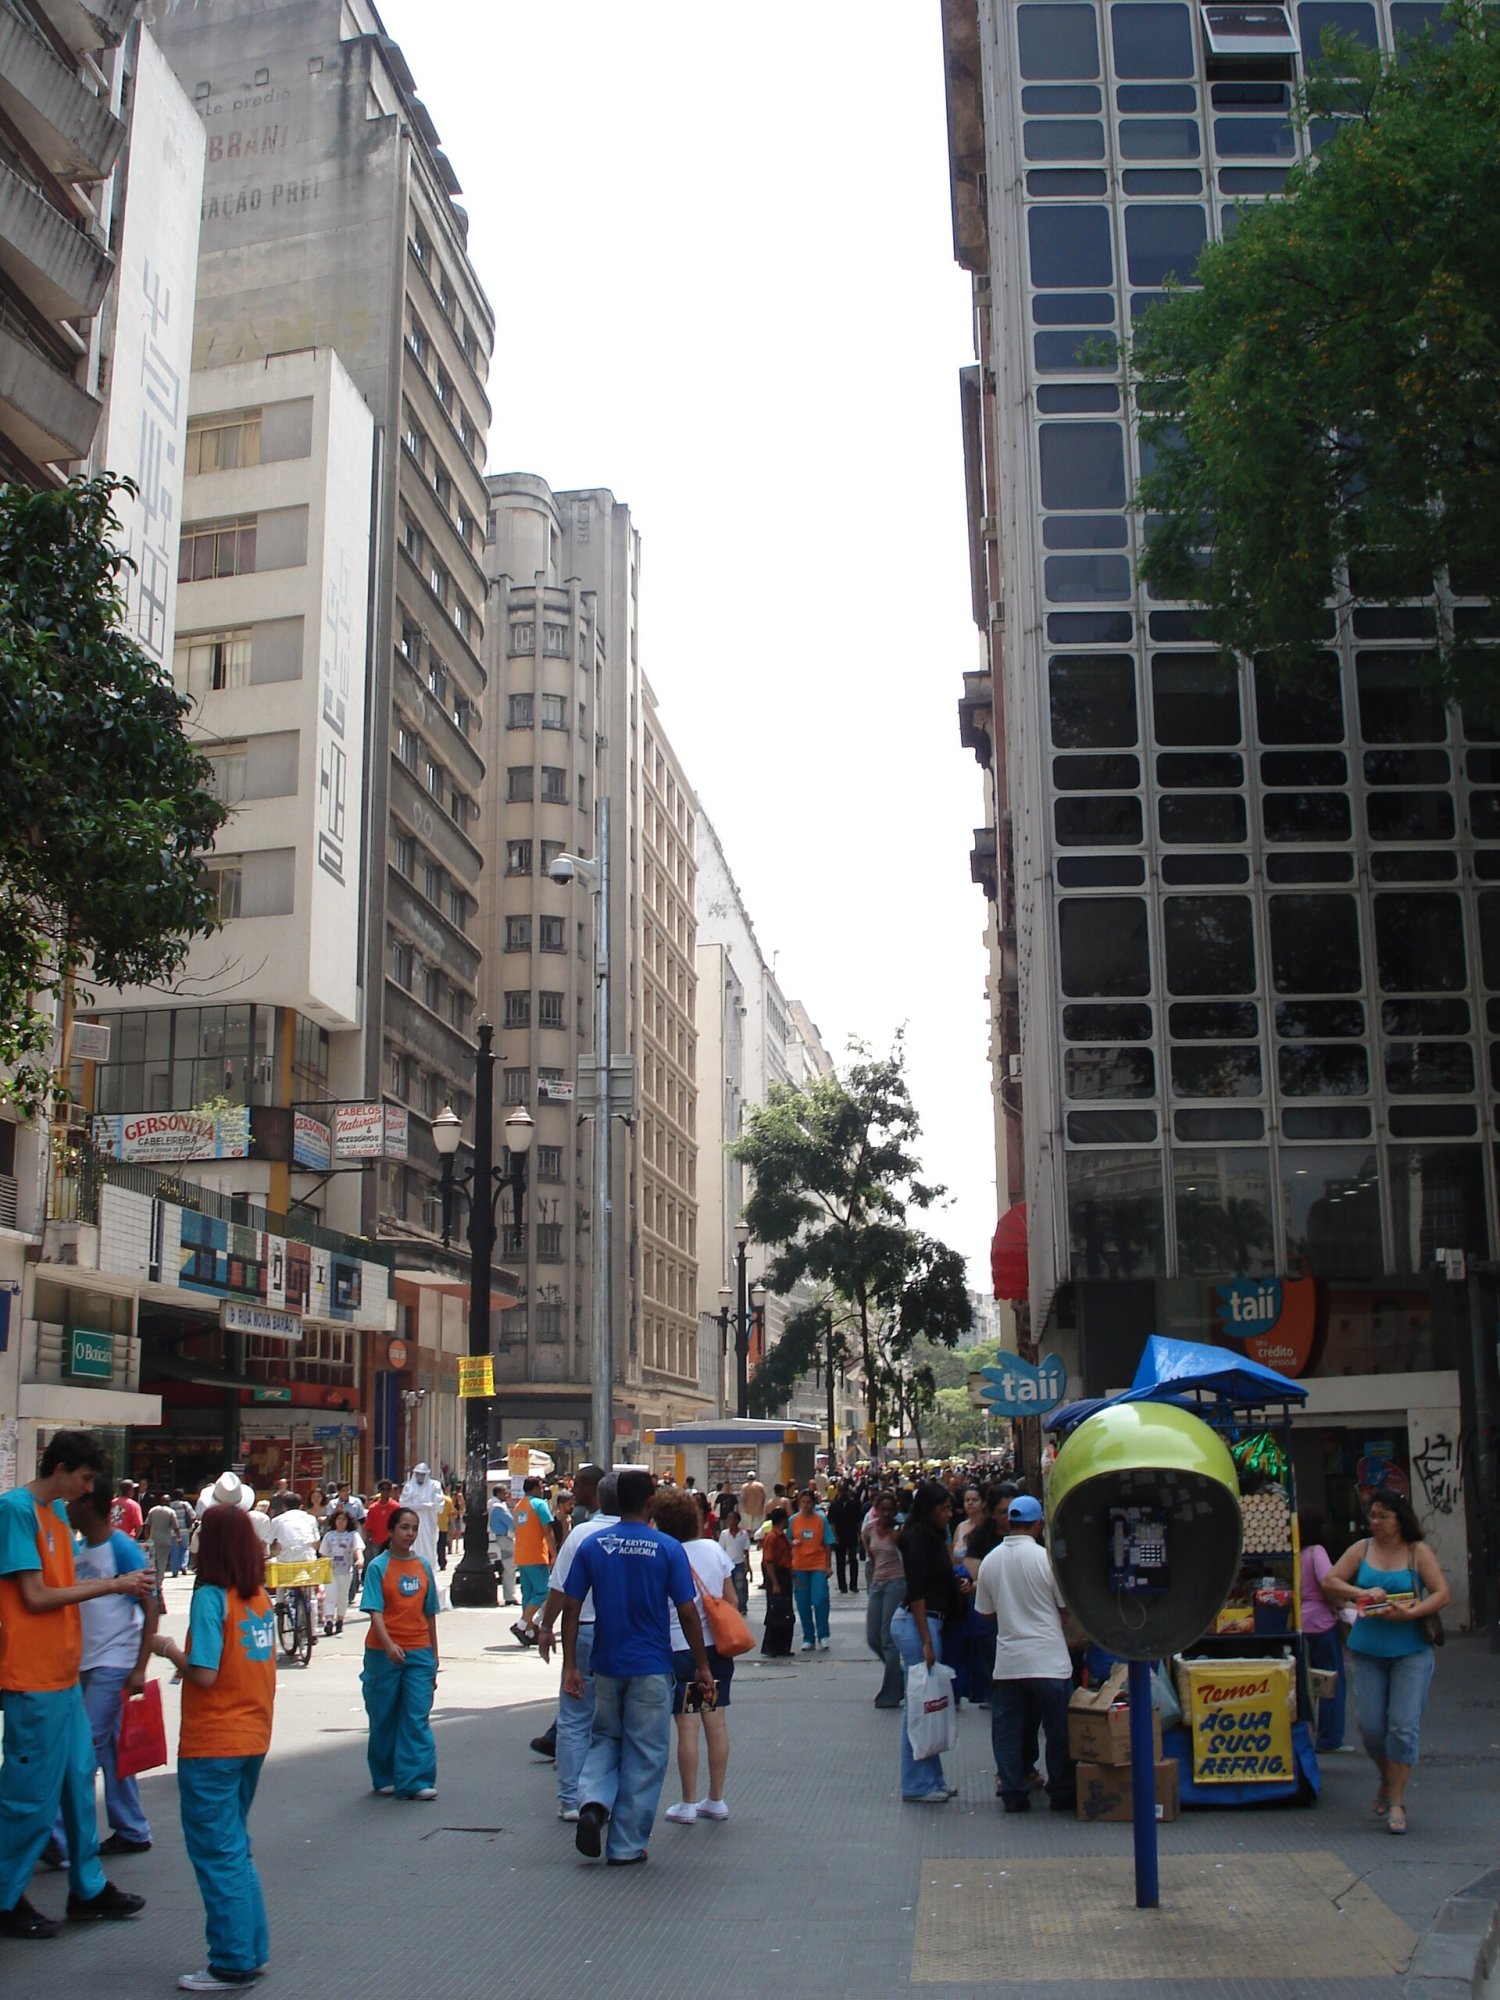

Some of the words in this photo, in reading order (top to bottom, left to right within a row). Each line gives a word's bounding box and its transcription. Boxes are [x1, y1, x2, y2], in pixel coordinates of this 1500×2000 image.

[337, 1106, 382, 1116] CABELOS
[124, 1114, 214, 1142] GERSONITA
[1230, 1287, 1275, 1322] taií
[238, 1308, 251, 1326] RUA
[253, 1311, 271, 1330] NOVA
[272, 1315, 294, 1333] BARÃO
[75, 1342, 84, 1360] O
[1258, 1345, 1294, 1358] crédito
[1001, 1370, 1059, 1402] taií
[619, 1547, 656, 1557] ACADEMIA
[1197, 1678, 1270, 1704] Temos
[1200, 1708, 1272, 1732] ÁGUA
[1208, 1733, 1272, 1754] SUCO
[1199, 1755, 1287, 1776] REFRIG.
